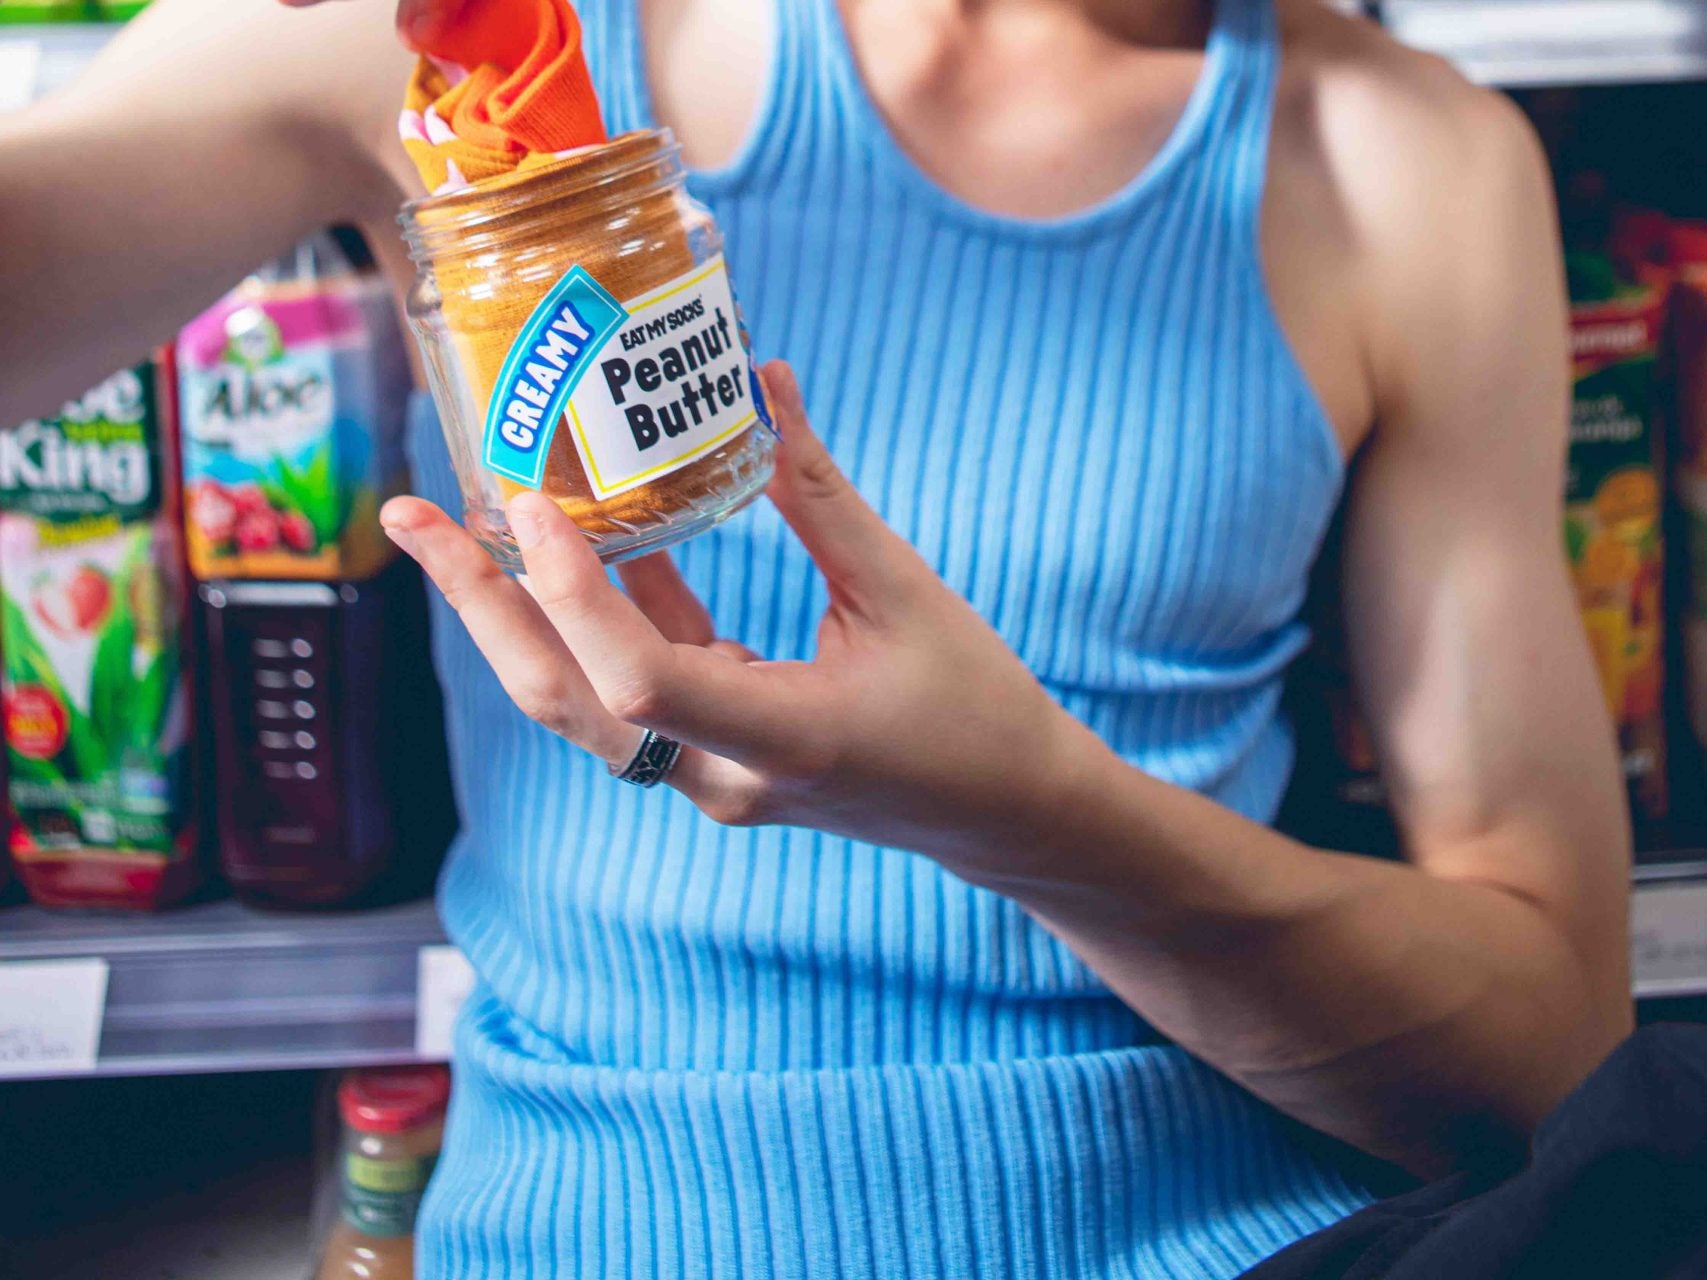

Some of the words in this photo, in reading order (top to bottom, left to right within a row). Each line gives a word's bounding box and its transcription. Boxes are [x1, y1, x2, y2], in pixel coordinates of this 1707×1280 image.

[600, 306, 732, 406] Peanut
[619, 324, 647, 351] EAT
[645, 315, 668, 341] MY
[665, 297, 706, 331] SOCKS
[500, 305, 592, 449] CREAMY
[624, 363, 745, 452] Butter
[0, 421, 150, 506] King
